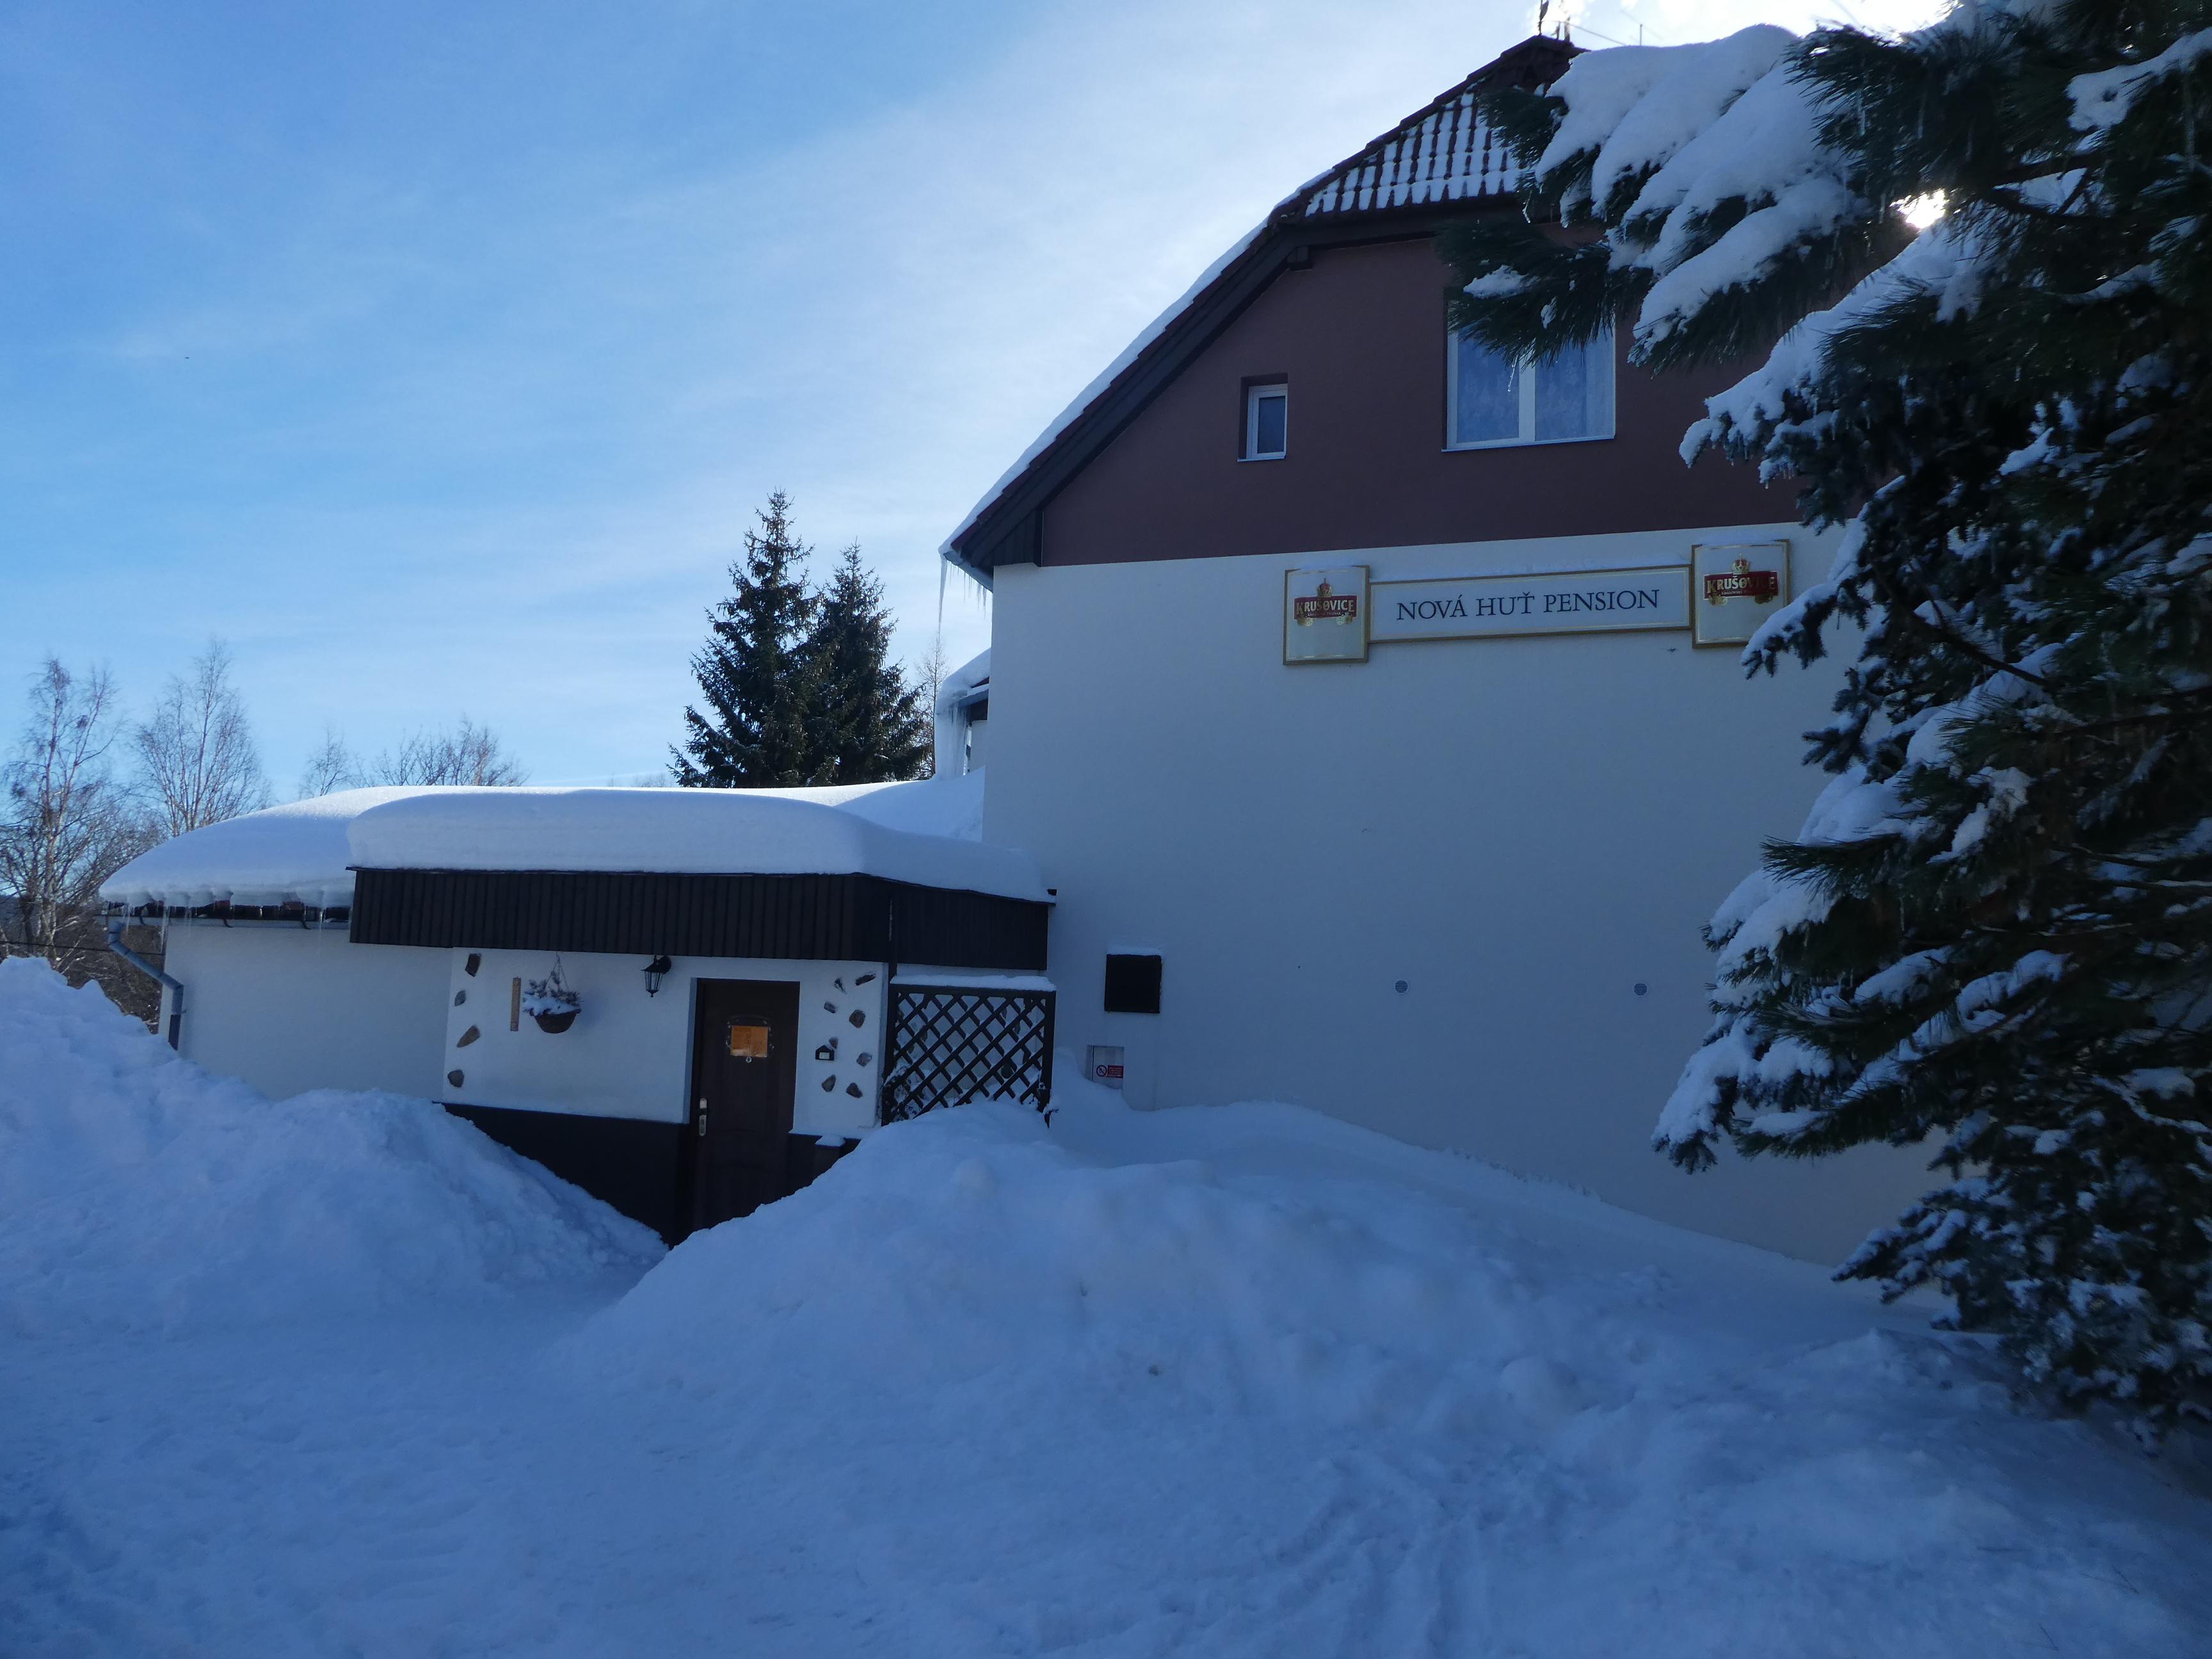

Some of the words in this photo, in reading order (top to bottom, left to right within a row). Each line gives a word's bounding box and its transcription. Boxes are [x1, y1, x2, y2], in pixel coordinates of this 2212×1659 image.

[1397, 594, 1468, 620] NOVÁ
[1475, 591, 1535, 616] HUŤ
[1543, 589, 1660, 613] PENSION
